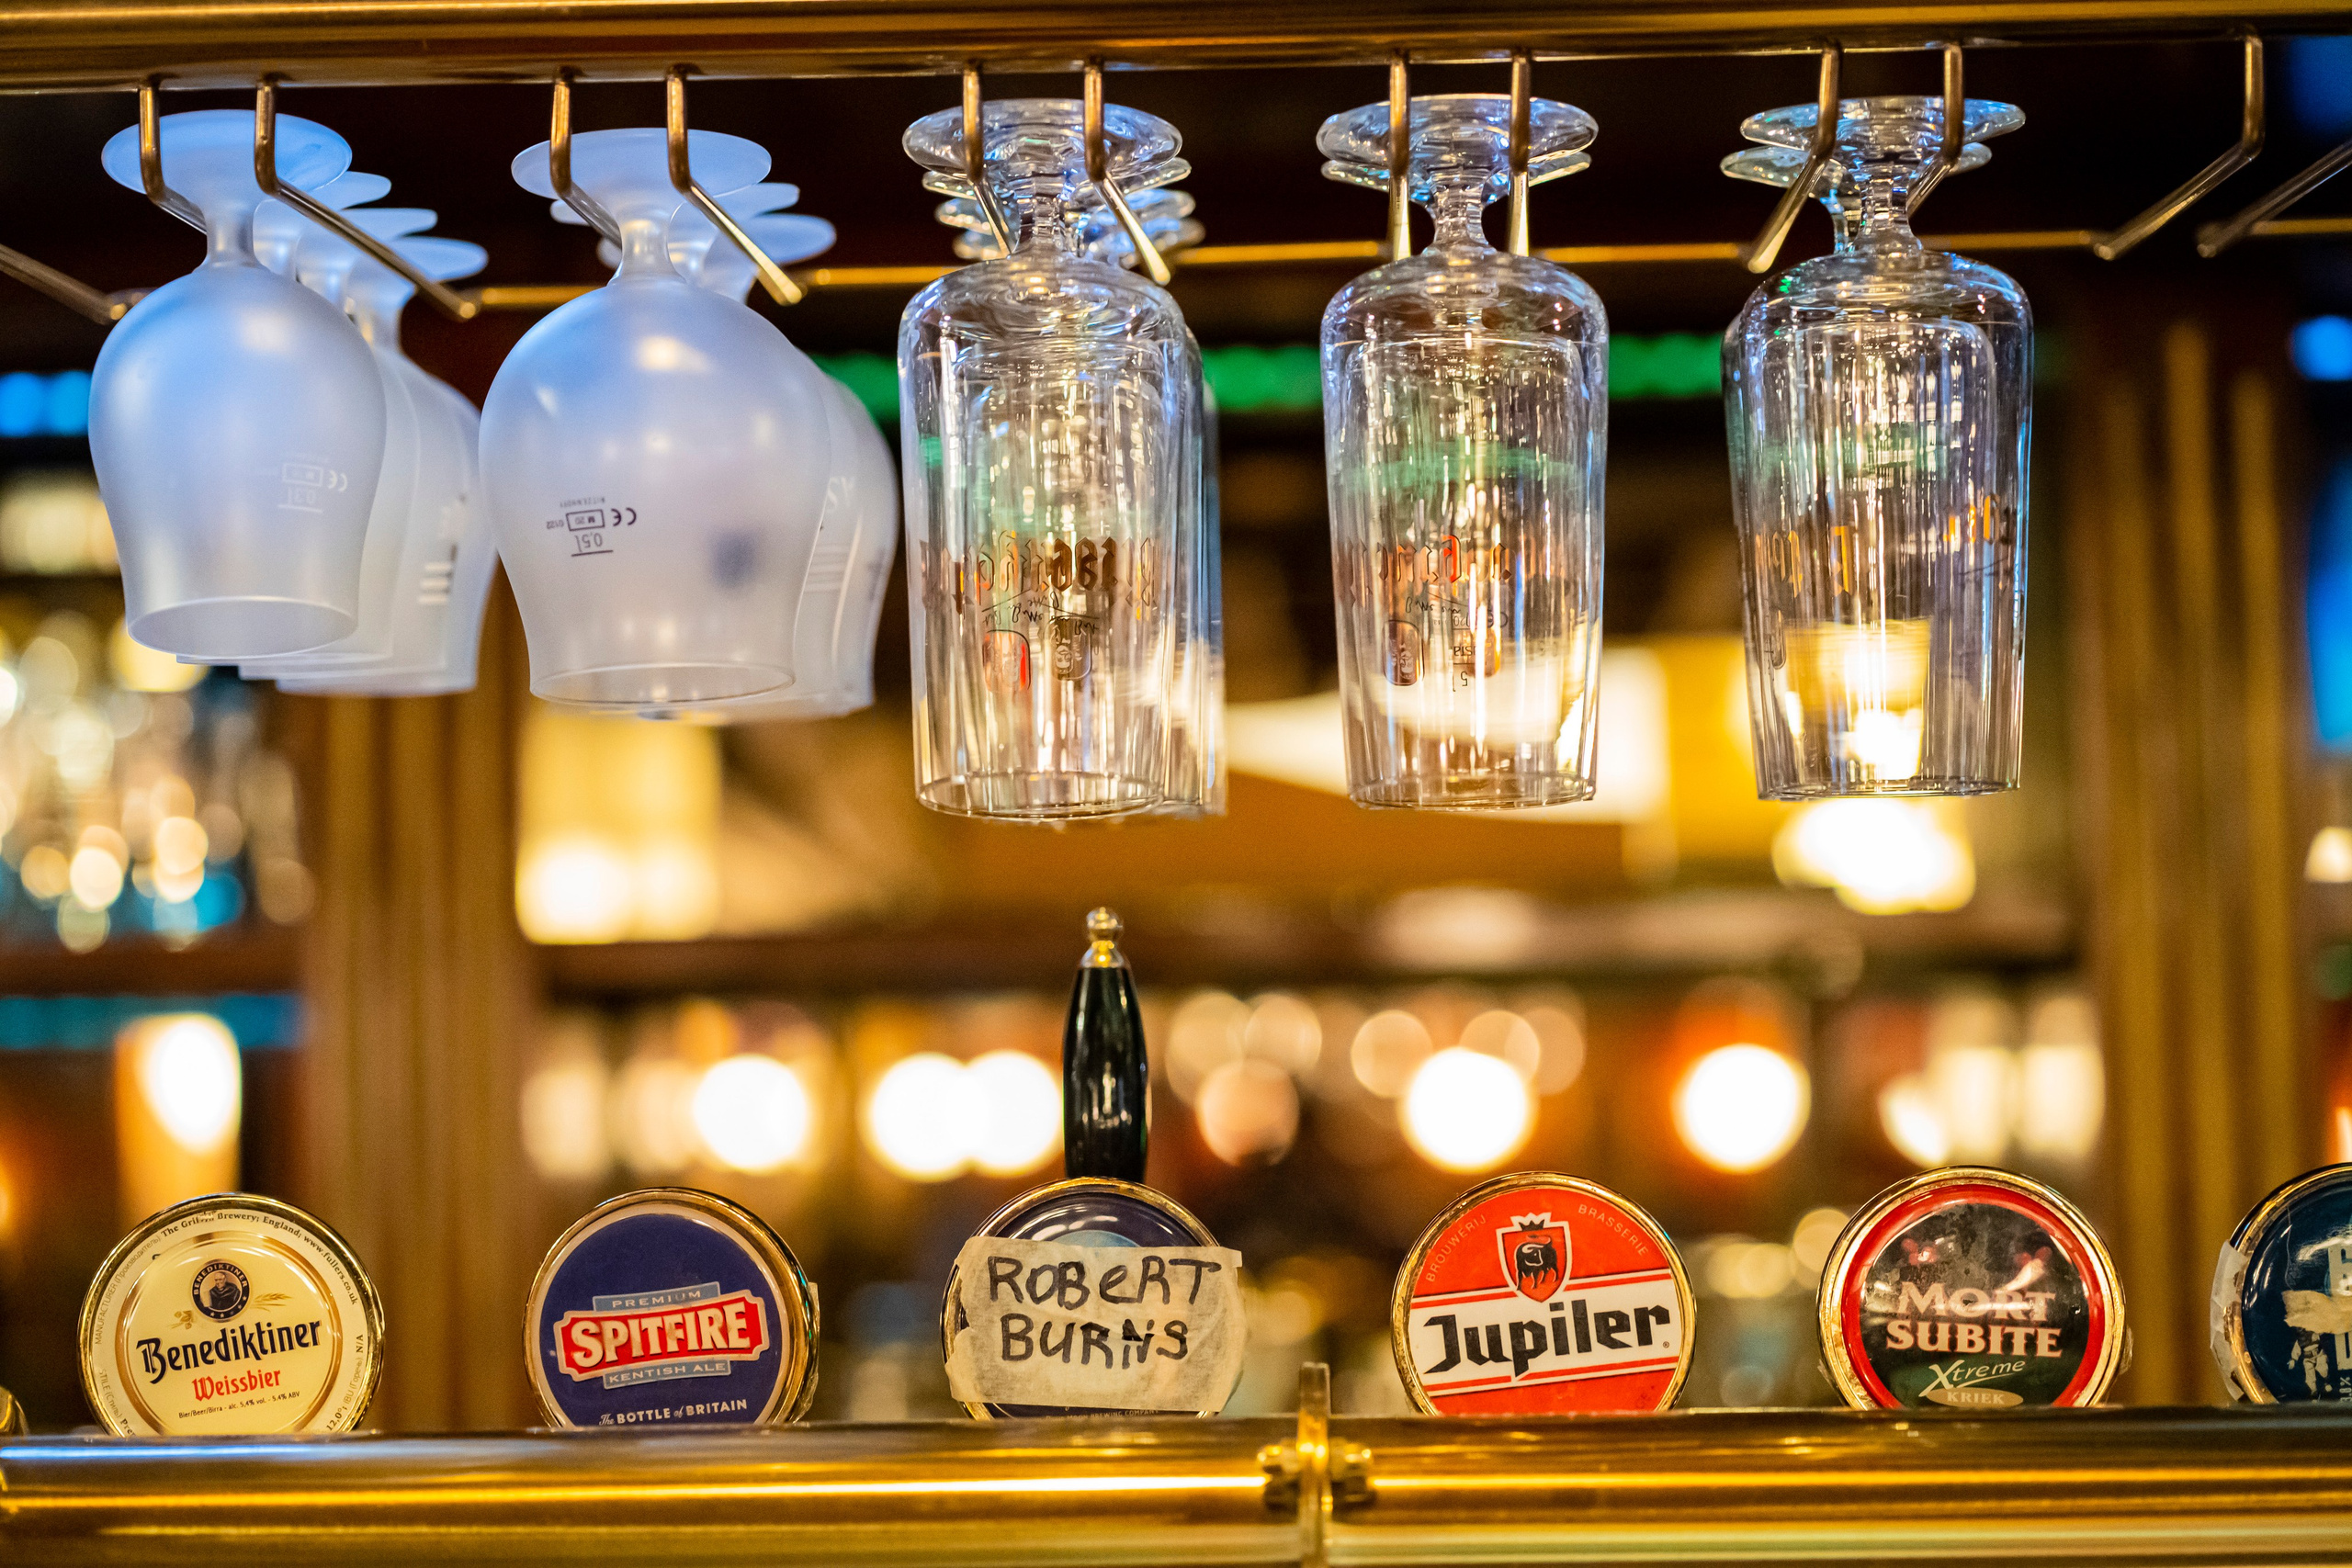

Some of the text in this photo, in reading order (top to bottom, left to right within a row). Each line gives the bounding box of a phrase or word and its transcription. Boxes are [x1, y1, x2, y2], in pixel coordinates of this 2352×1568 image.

[611, 507, 637, 527] CE
[1426, 1203, 1649, 1283] BROUWERIJ BRASSERIE
[95, 1283, 117, 1345] MANUFACTURER
[161, 1225, 178, 1237] The
[303, 1235, 358, 1305] www.fullers.co.uk
[193, 1263, 248, 1295] BENEDIKTINER
[612, 1290, 701, 1309] PREMIUM
[356, 1334, 364, 1353] N/A
[571, 1300, 752, 1369] SPITFIRE
[1001, 1313, 1189, 1371] BURNS
[1886, 1320, 2063, 1358] SUBITE
[136, 1319, 322, 1385] Benediktiner
[191, 1369, 281, 1402] Weissbier
[608, 1361, 727, 1383] KENTISH ALE
[1918, 1359, 2026, 1397] Xtreme
[599, 1398, 748, 1426] The BOTTLE of BRITAIN
[1947, 1391, 2005, 1405] KRIEK
